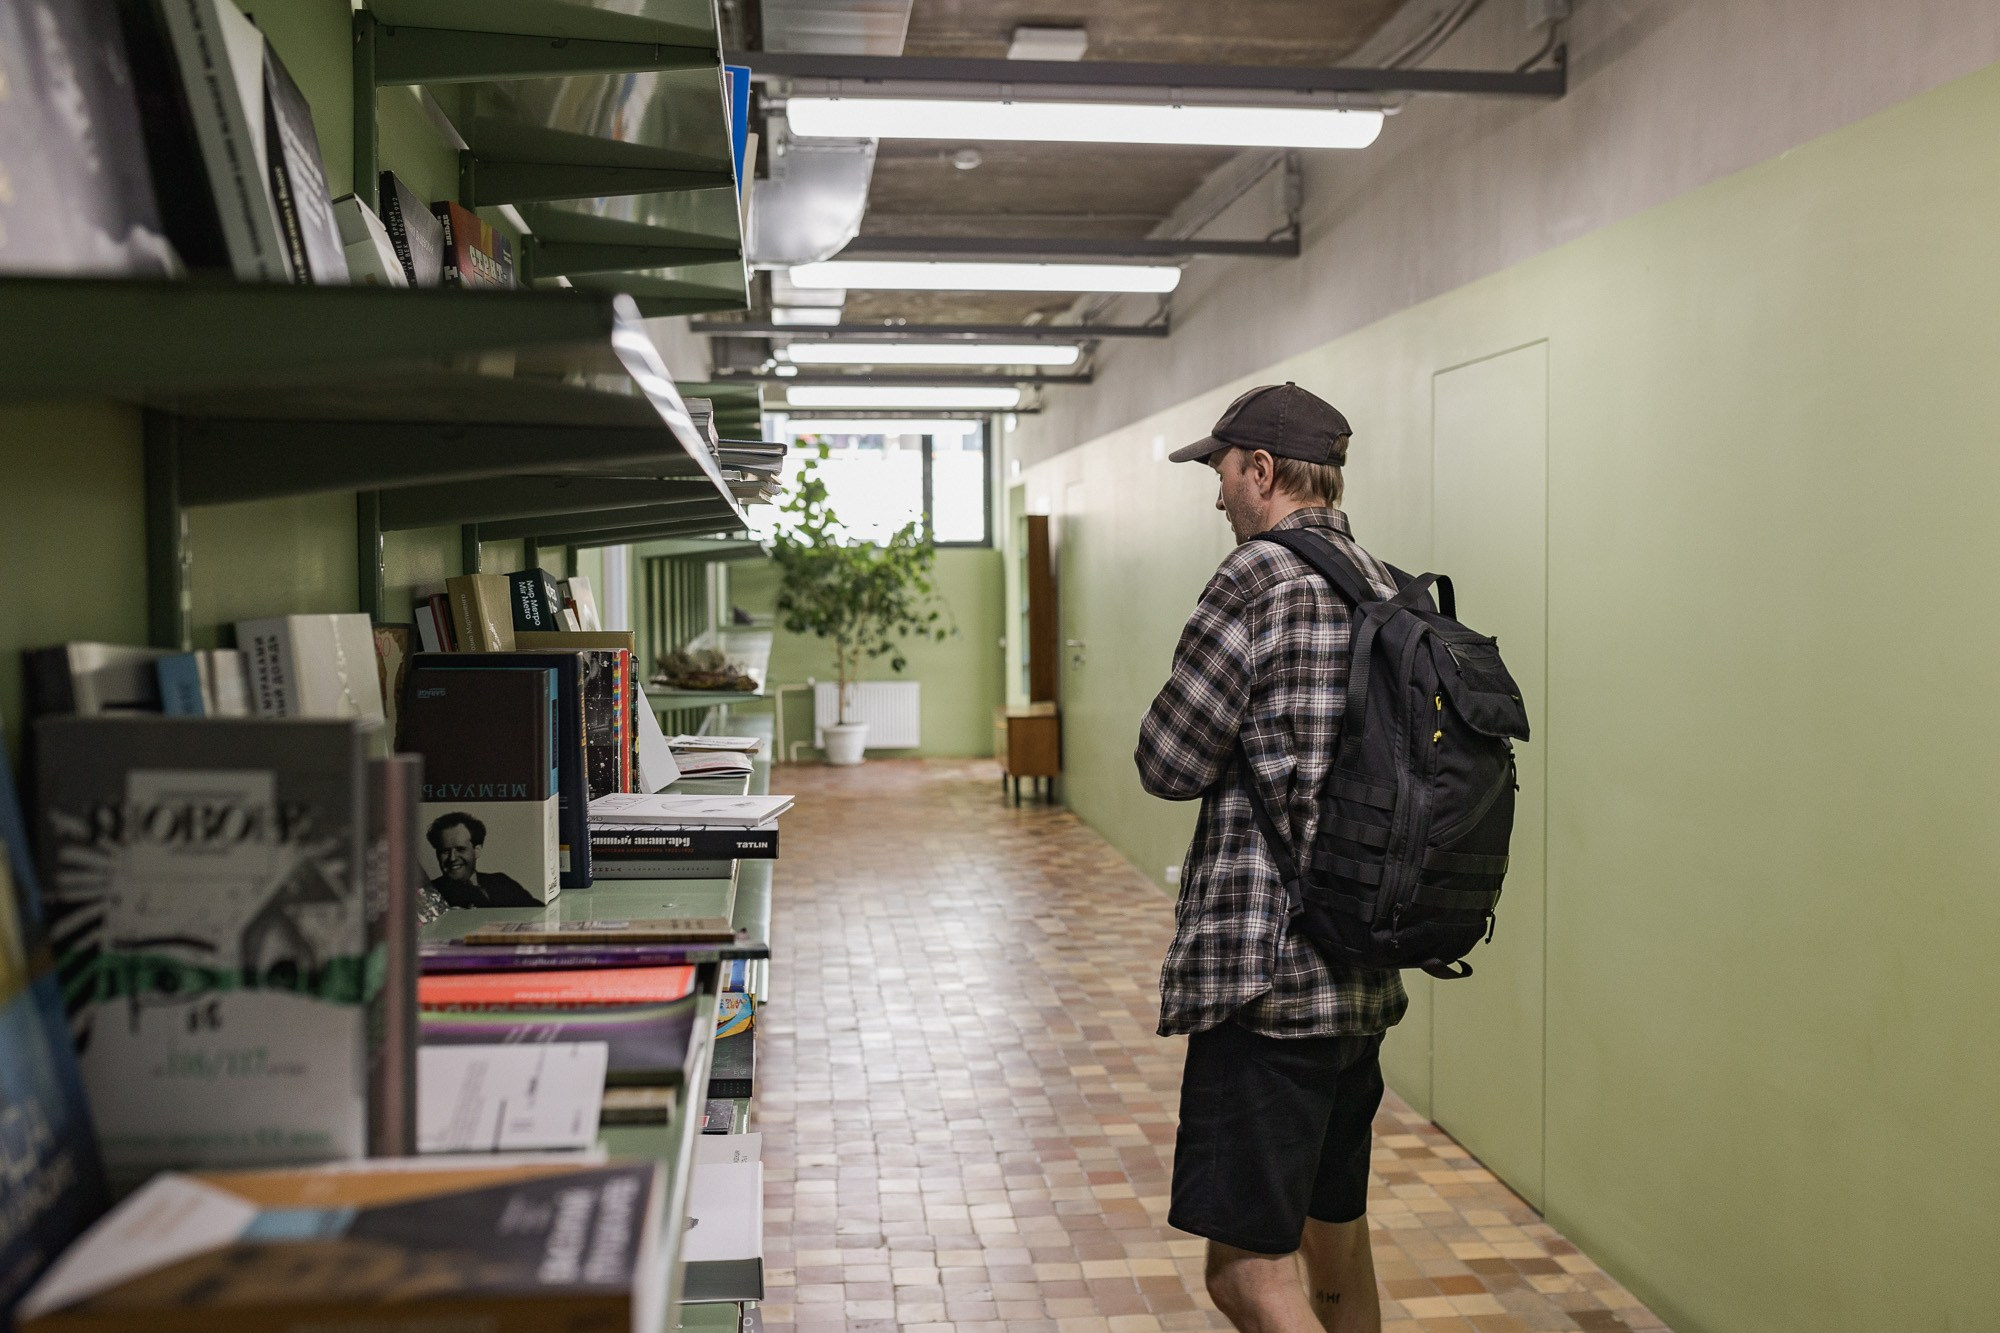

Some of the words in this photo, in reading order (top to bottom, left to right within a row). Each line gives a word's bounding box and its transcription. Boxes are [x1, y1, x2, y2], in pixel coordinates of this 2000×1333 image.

[389, 211, 399, 236] ВРЕМЯ
[392, 197, 405, 236] 1962-1992
[518, 581, 526, 595] Mir
[521, 595, 531, 620] Metro
[526, 580, 534, 599] Мир
[530, 599, 541, 626] Метро
[634, 837, 691, 847] авангард
